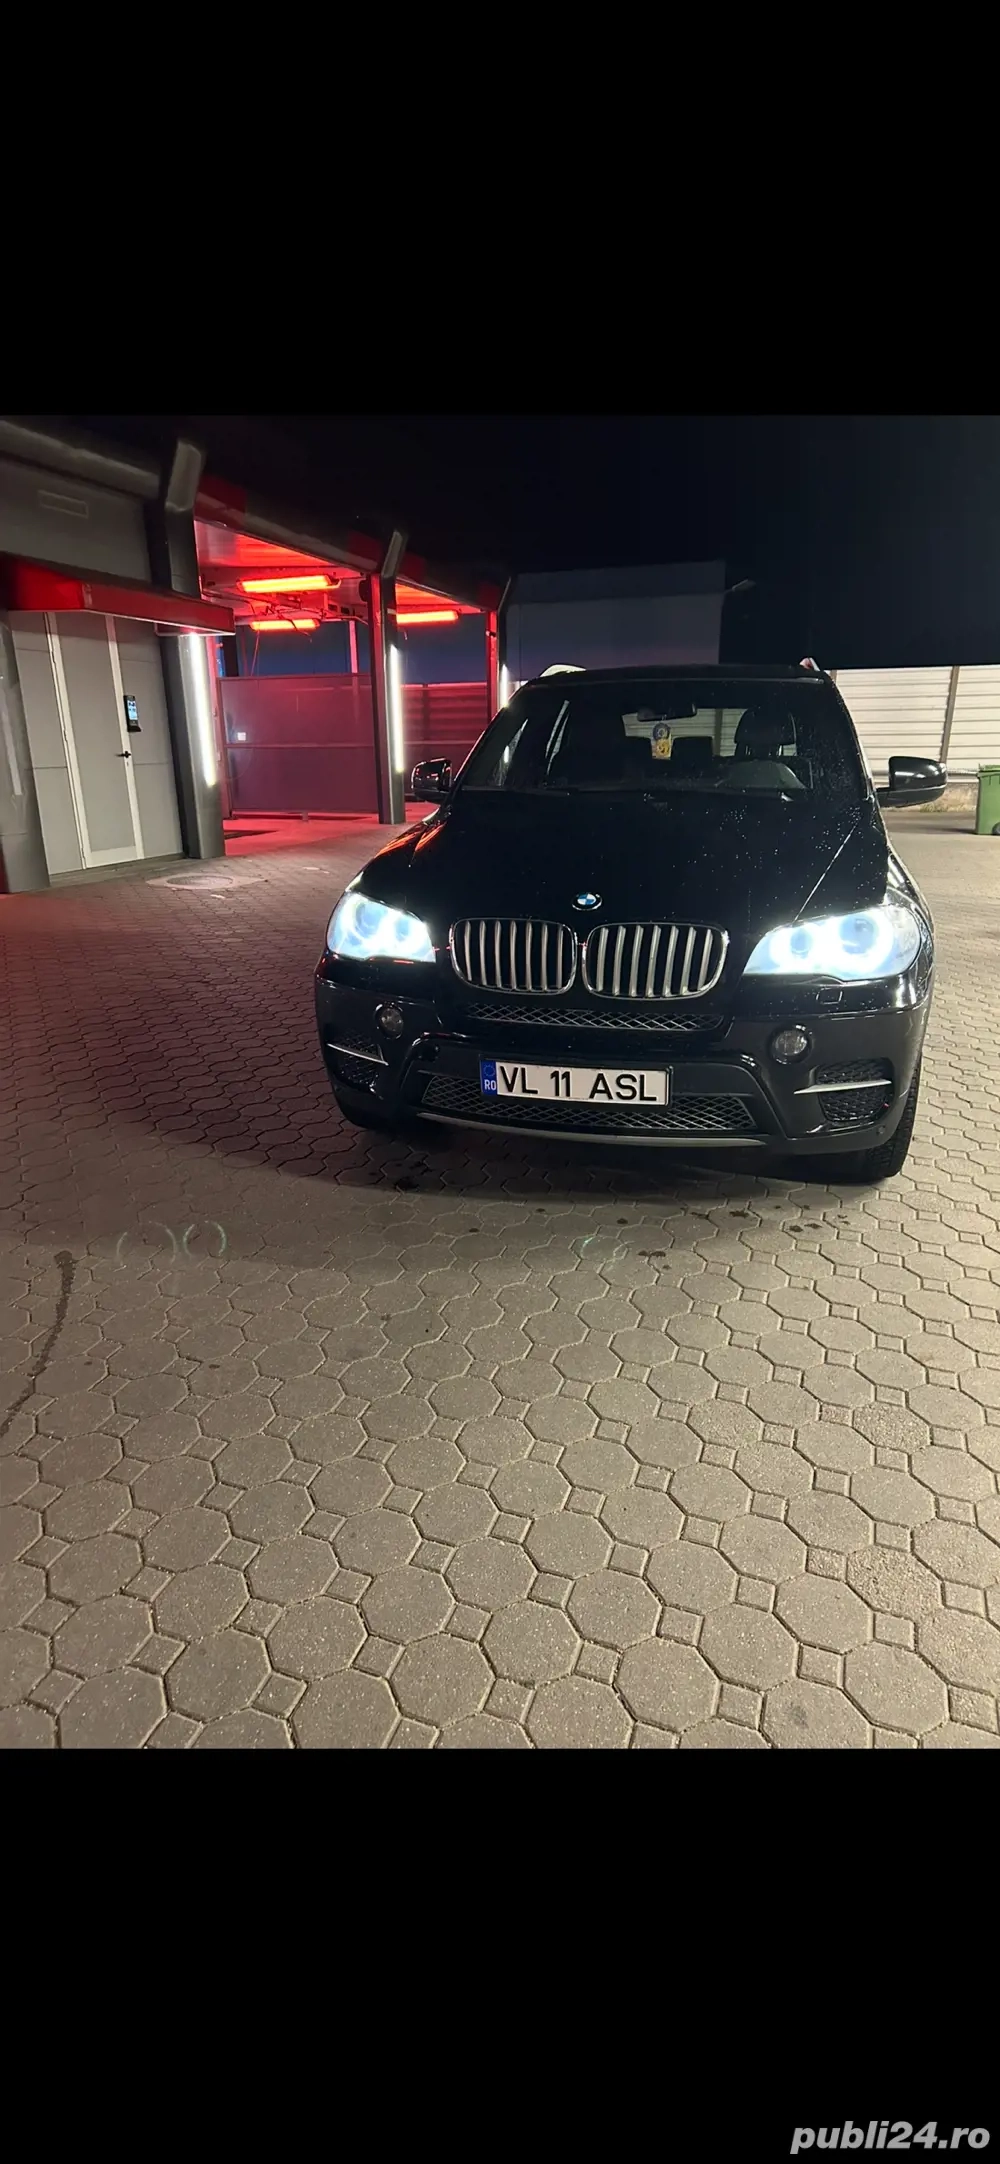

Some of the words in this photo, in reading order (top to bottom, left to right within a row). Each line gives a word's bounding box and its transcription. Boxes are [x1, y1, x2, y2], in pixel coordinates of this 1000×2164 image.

[484, 1079, 497, 1091] RO
[500, 1066, 538, 1094] VL
[550, 1070, 570, 1097] 11
[589, 1073, 657, 1101] ASL
